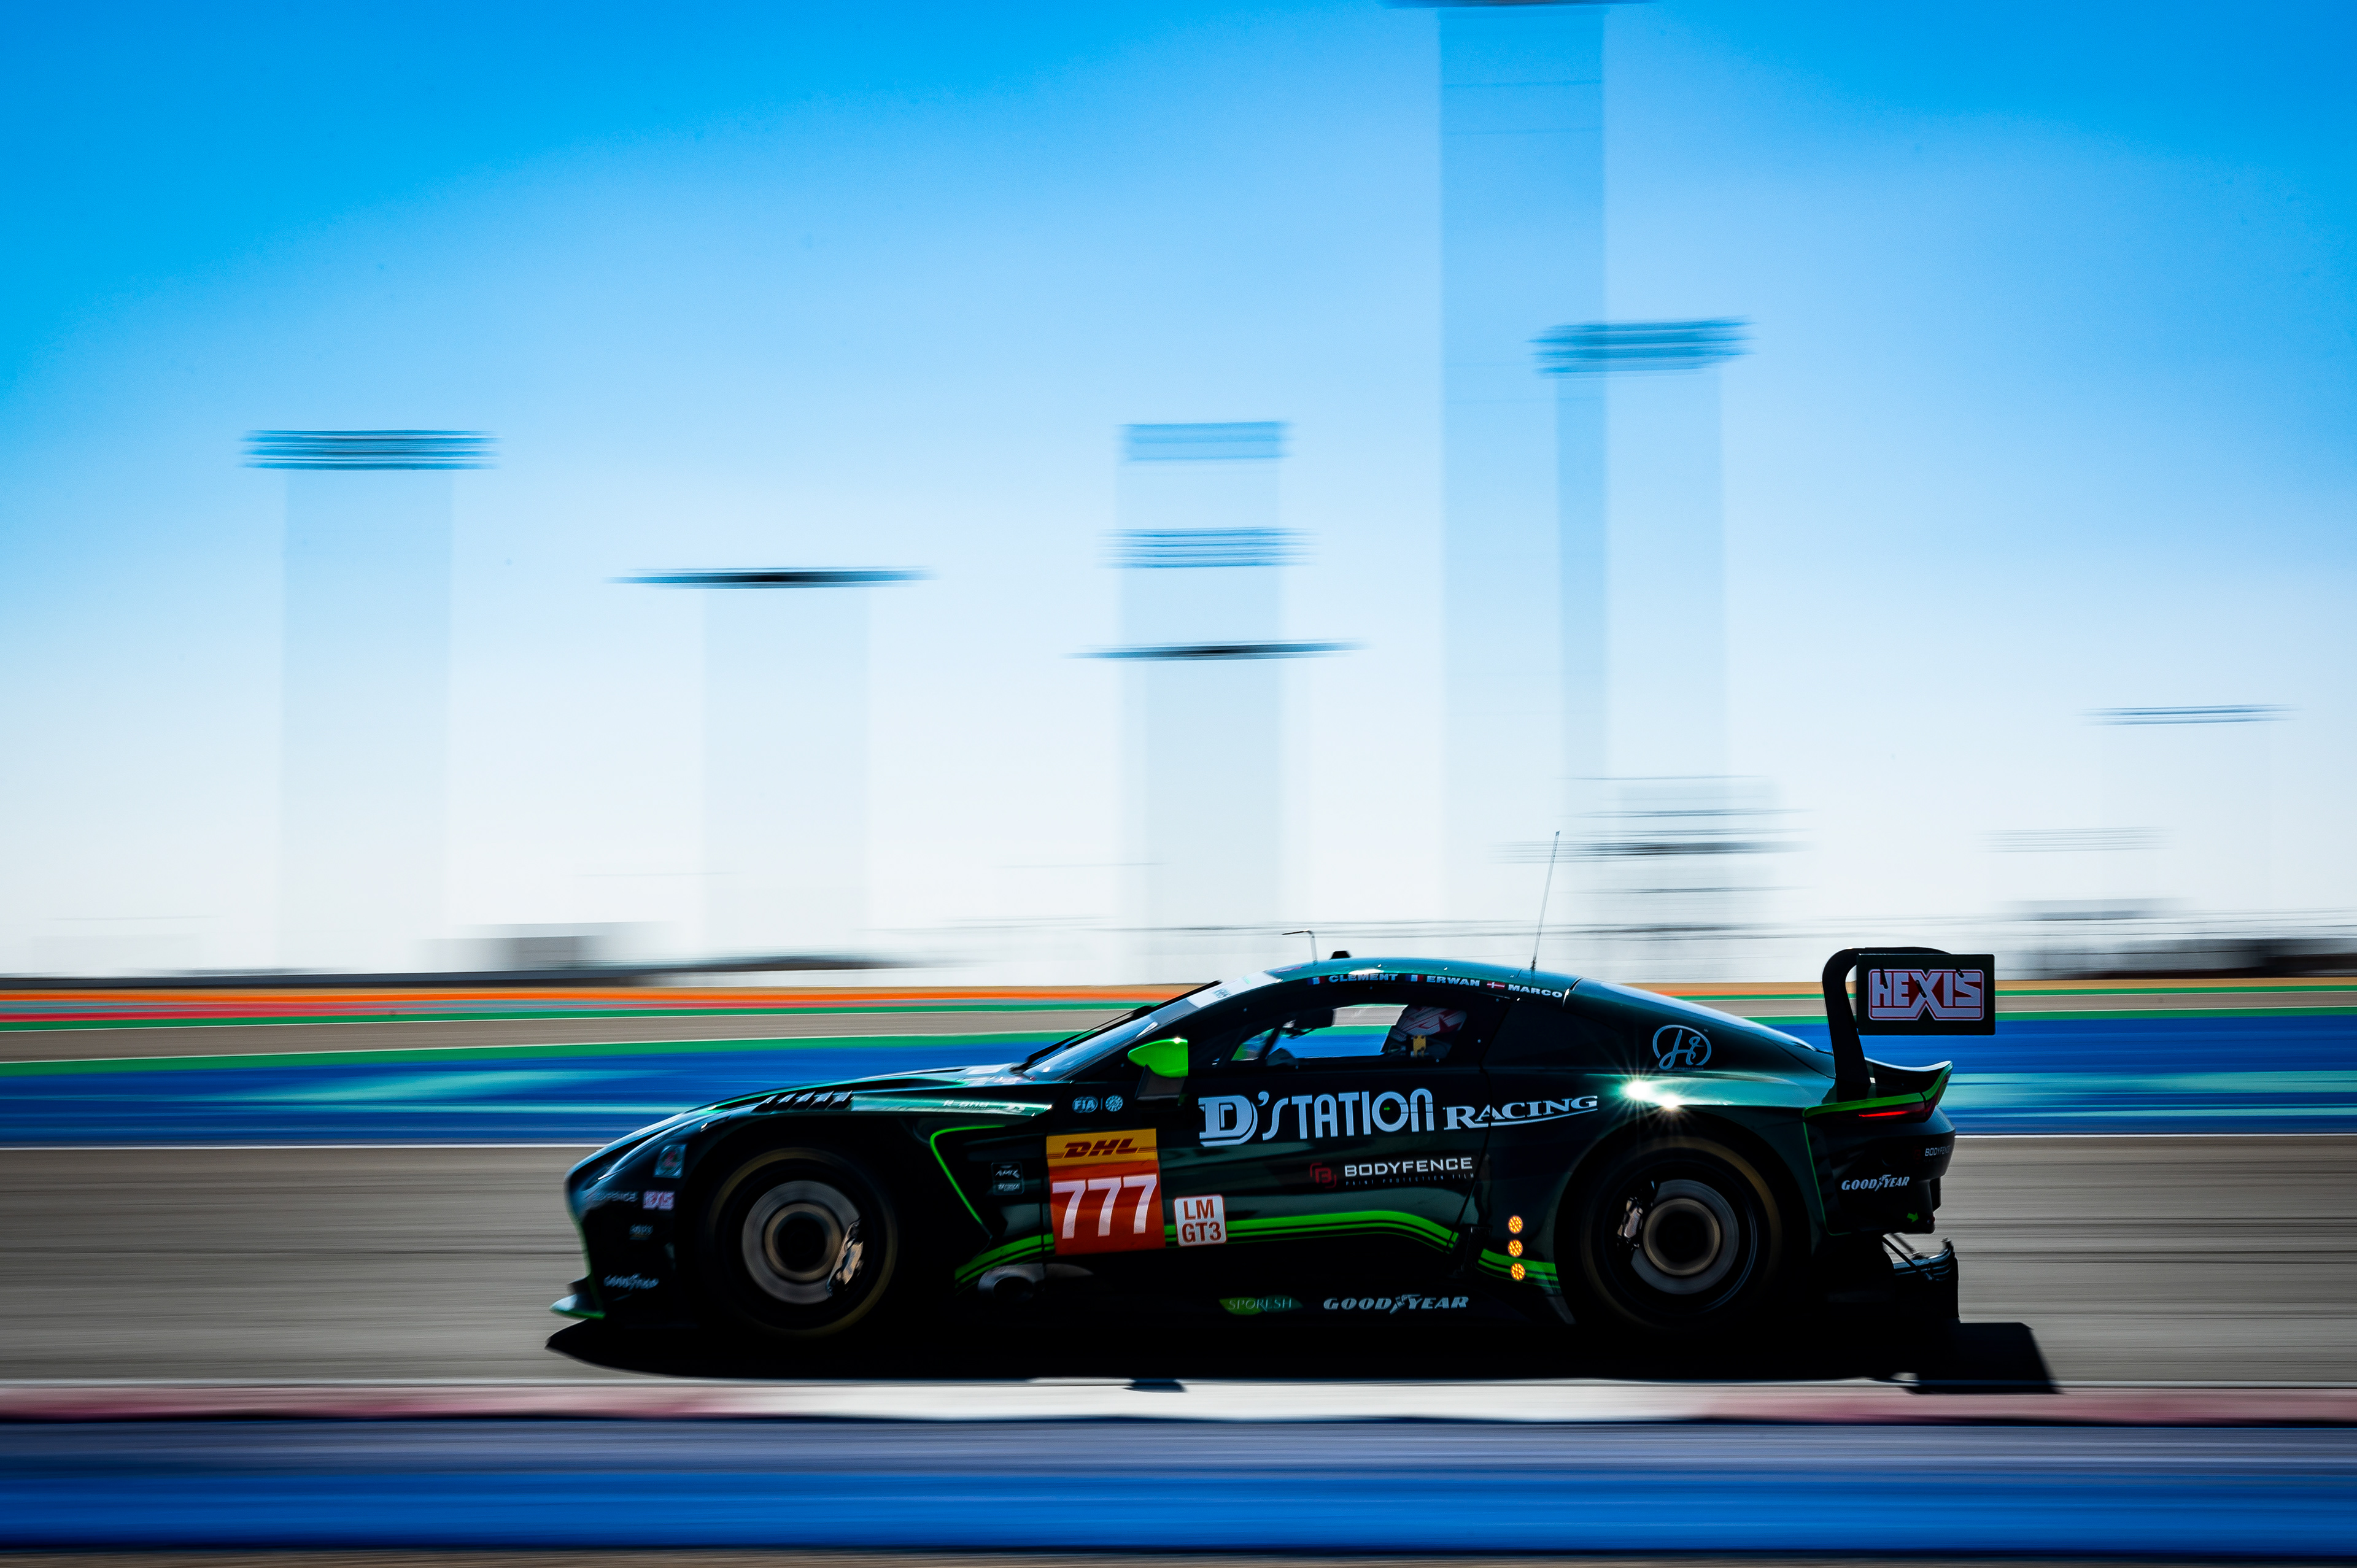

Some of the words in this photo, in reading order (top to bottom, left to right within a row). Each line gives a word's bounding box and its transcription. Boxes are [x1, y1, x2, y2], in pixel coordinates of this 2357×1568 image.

[1426, 975, 1480, 987] ERWAN
[1508, 984, 1563, 998] MARCO
[1871, 971, 1982, 1018] HEXIS
[1073, 1099, 1097, 1111] FIA
[1442, 1095, 1598, 1130] RACING
[1064, 1139, 1139, 1158] DHL
[1344, 1157, 1473, 1177] BODYFENCE
[1052, 1173, 1157, 1240] 777
[1183, 1199, 1214, 1220] LM
[1182, 1222, 1221, 1243] GT3
